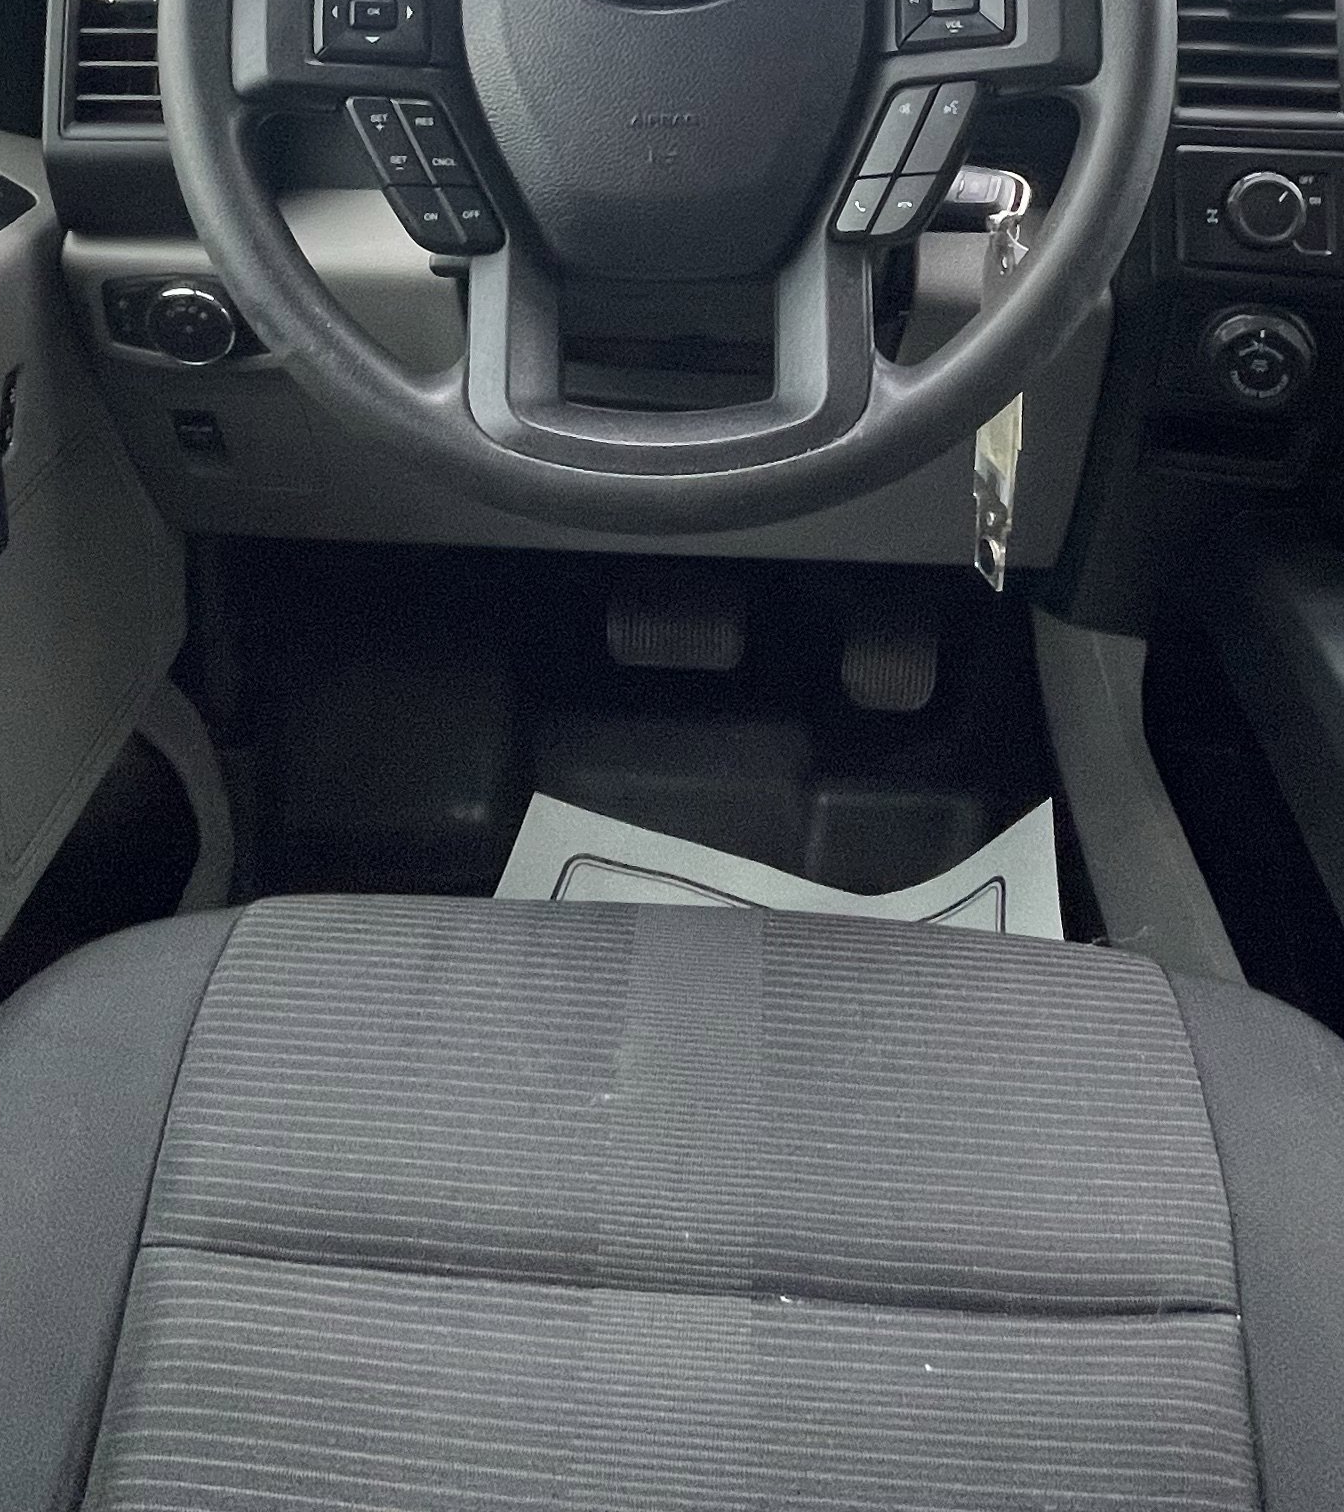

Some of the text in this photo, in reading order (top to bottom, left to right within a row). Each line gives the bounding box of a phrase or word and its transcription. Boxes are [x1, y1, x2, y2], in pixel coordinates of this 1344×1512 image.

[945, 20, 964, 29] VOL
[423, 212, 438, 221] ON
[462, 210, 480, 219] OFF
